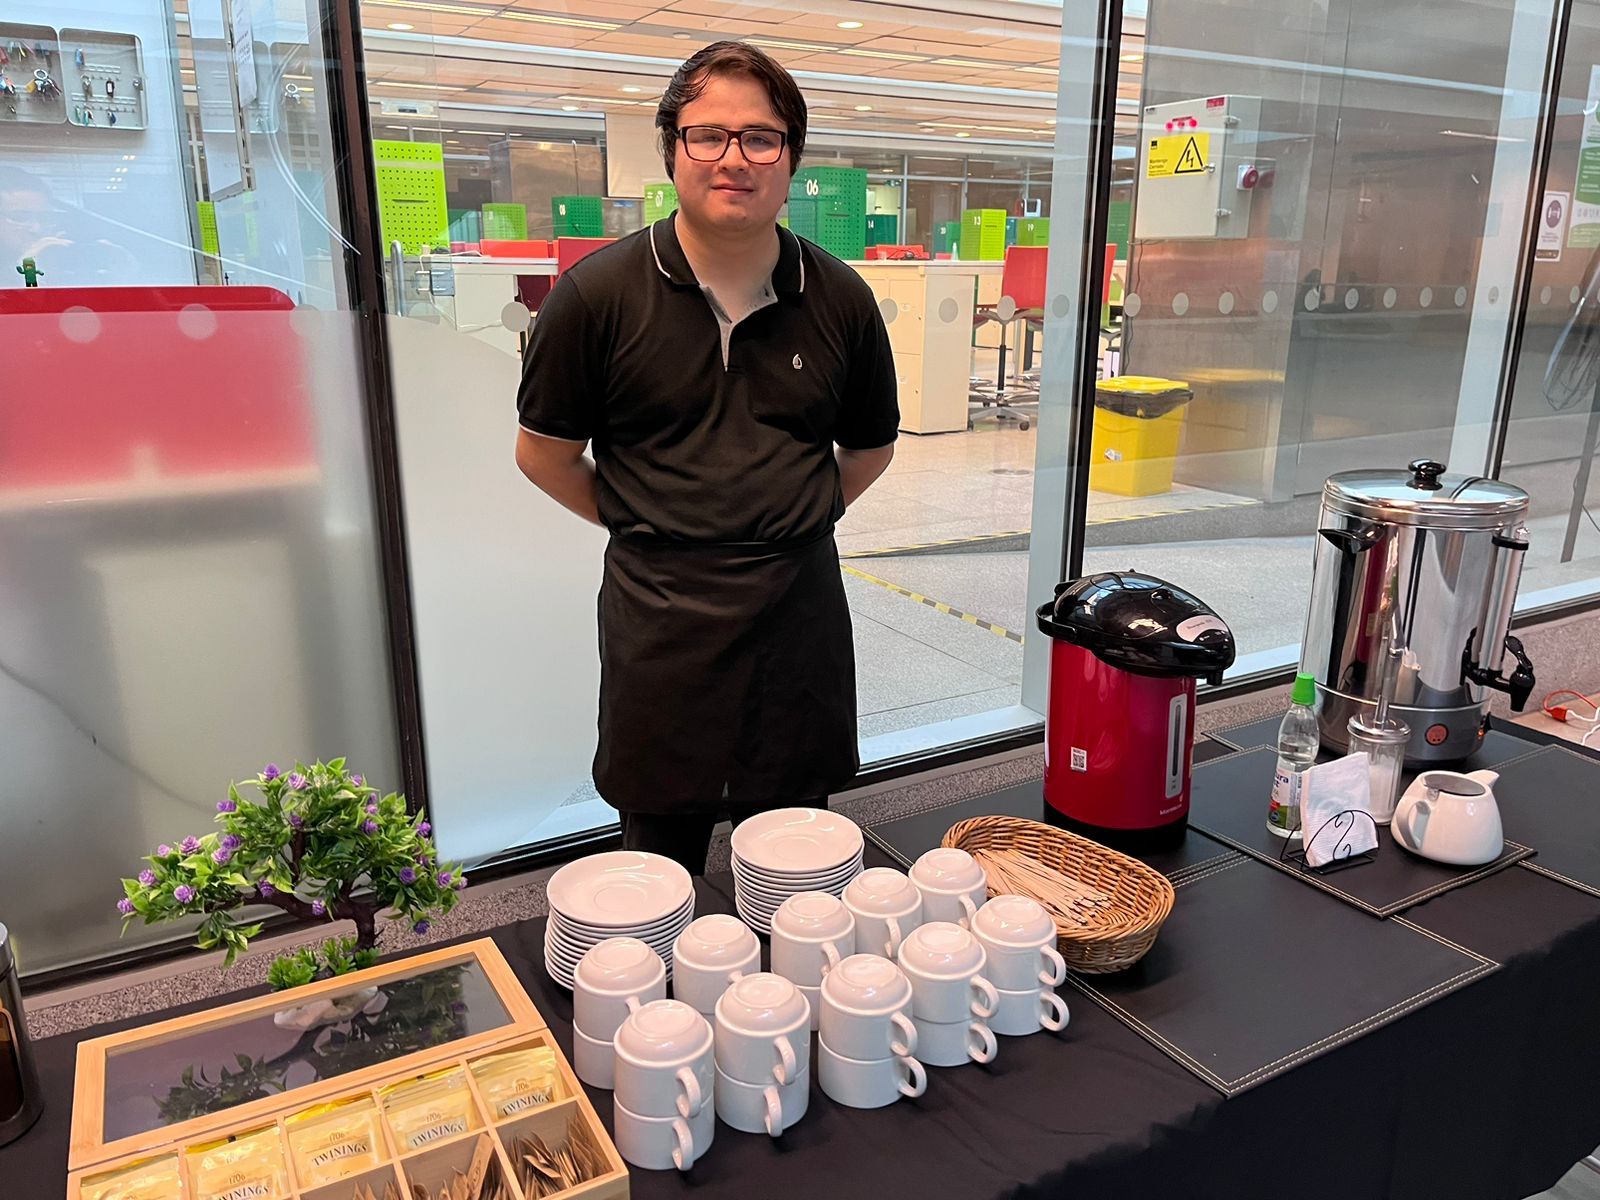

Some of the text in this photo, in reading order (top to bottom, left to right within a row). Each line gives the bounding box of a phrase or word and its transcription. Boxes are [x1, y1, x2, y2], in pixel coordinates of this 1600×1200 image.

[806, 179, 819, 196] 06
[973, 216, 981, 226] 13
[514, 1079, 530, 1092] 1706
[501, 1093, 552, 1116] TWININGS
[424, 1112, 442, 1123] 1706
[411, 1120, 465, 1147] TWININGS
[312, 1143, 368, 1167] TWININGS
[229, 1172, 246, 1184] 1706
[217, 1184, 270, 1200] WININGS
